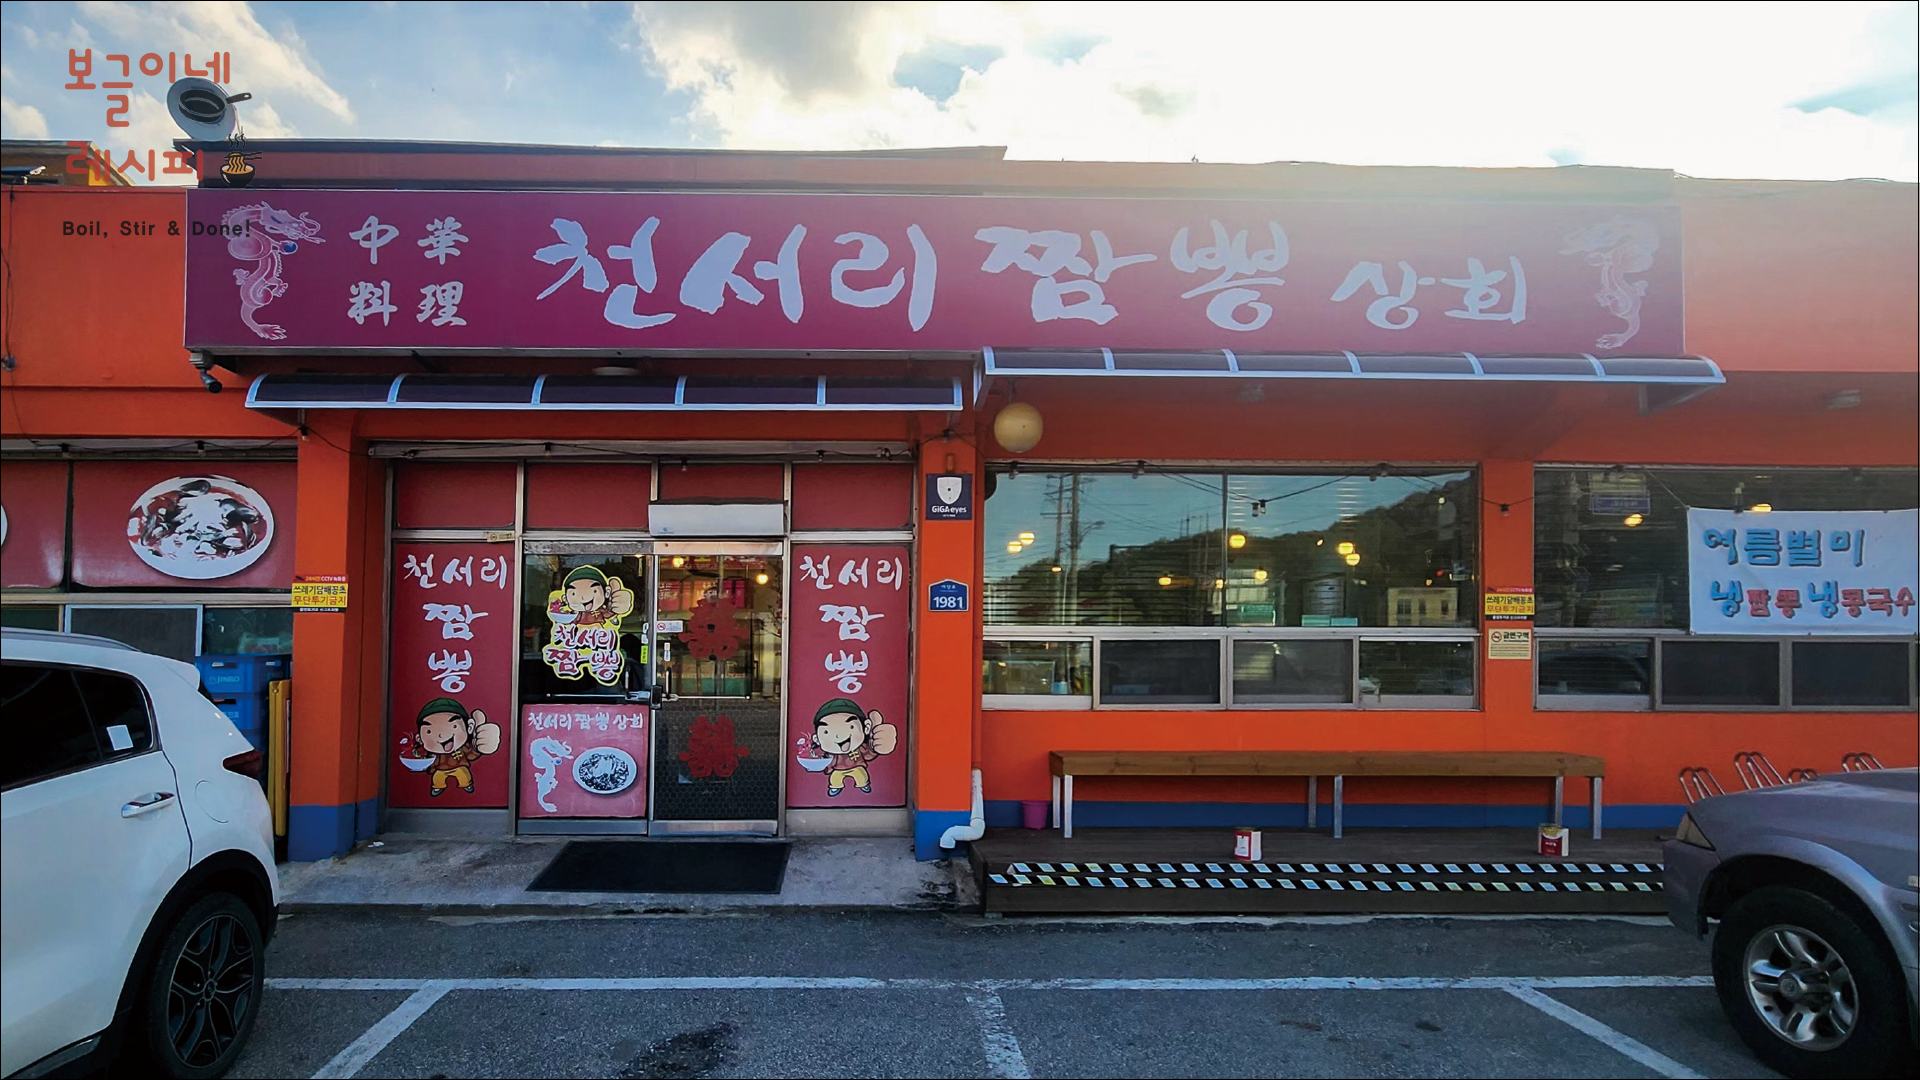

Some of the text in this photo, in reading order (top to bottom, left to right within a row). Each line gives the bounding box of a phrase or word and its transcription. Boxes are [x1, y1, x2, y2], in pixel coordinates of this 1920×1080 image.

[349, 215, 470, 266] 中華
[533, 216, 1528, 332] 천서리 짬뽕 상회
[347, 280, 468, 328] 料理
[403, 554, 508, 589] 천서리
[800, 555, 903, 590] 천서리
[932, 596, 963, 609] 1981
[554, 624, 615, 650] 천서리
[1503, 631, 1530, 640] 금연구역
[217, 676, 240, 684] JINRO
[546, 649, 621, 680] 짬뽕
[528, 712, 643, 731] 천서리 짬뽕 상회
